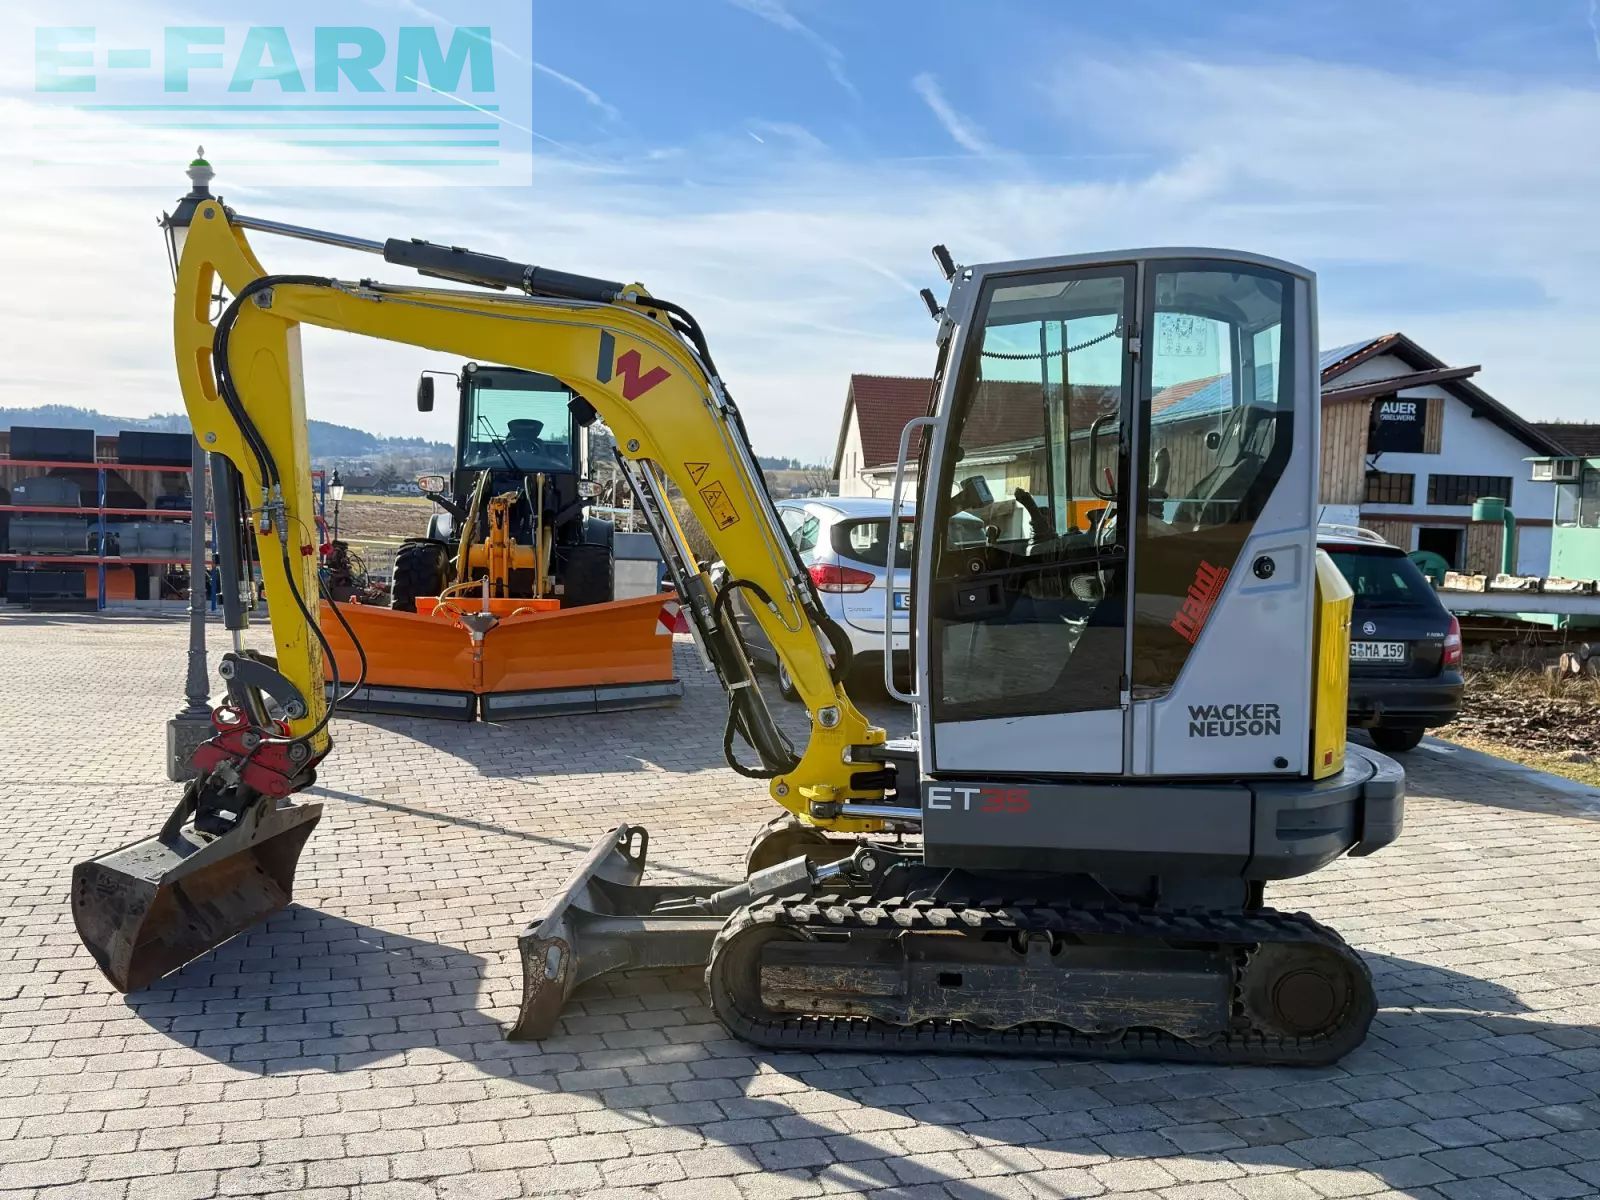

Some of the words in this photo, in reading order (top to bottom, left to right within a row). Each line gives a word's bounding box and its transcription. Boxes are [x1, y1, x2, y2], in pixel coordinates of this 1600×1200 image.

[1380, 402, 1416, 414] AUER
[1365, 644, 1380, 657] MA
[1382, 644, 1404, 658] 159
[1188, 704, 1280, 720] WACKER
[1189, 720, 1280, 737] NEUSON
[928, 787, 1031, 812] ET35
